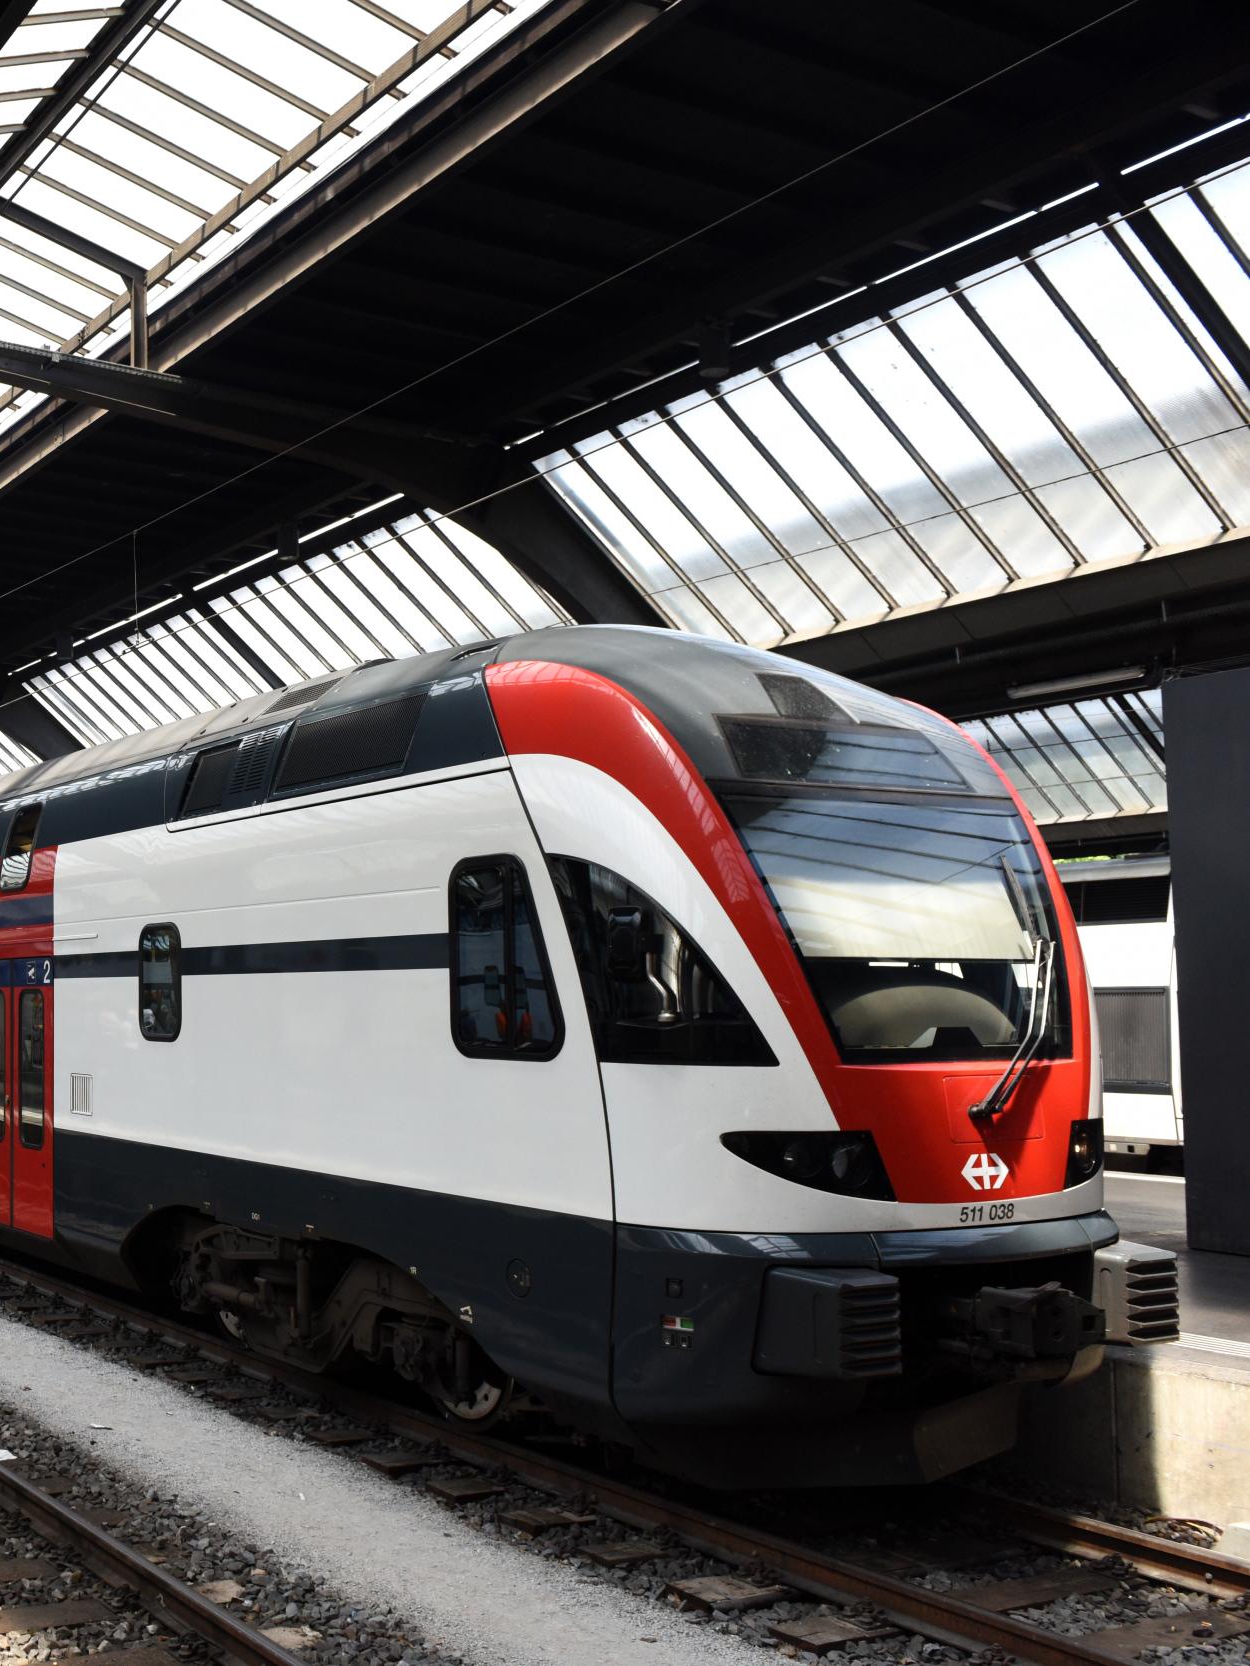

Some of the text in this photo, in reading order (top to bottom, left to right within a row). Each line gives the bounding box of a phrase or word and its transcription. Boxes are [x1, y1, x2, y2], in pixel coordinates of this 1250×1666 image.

[43, 960, 50, 983] 2
[959, 1202, 1015, 1223] 511 038
